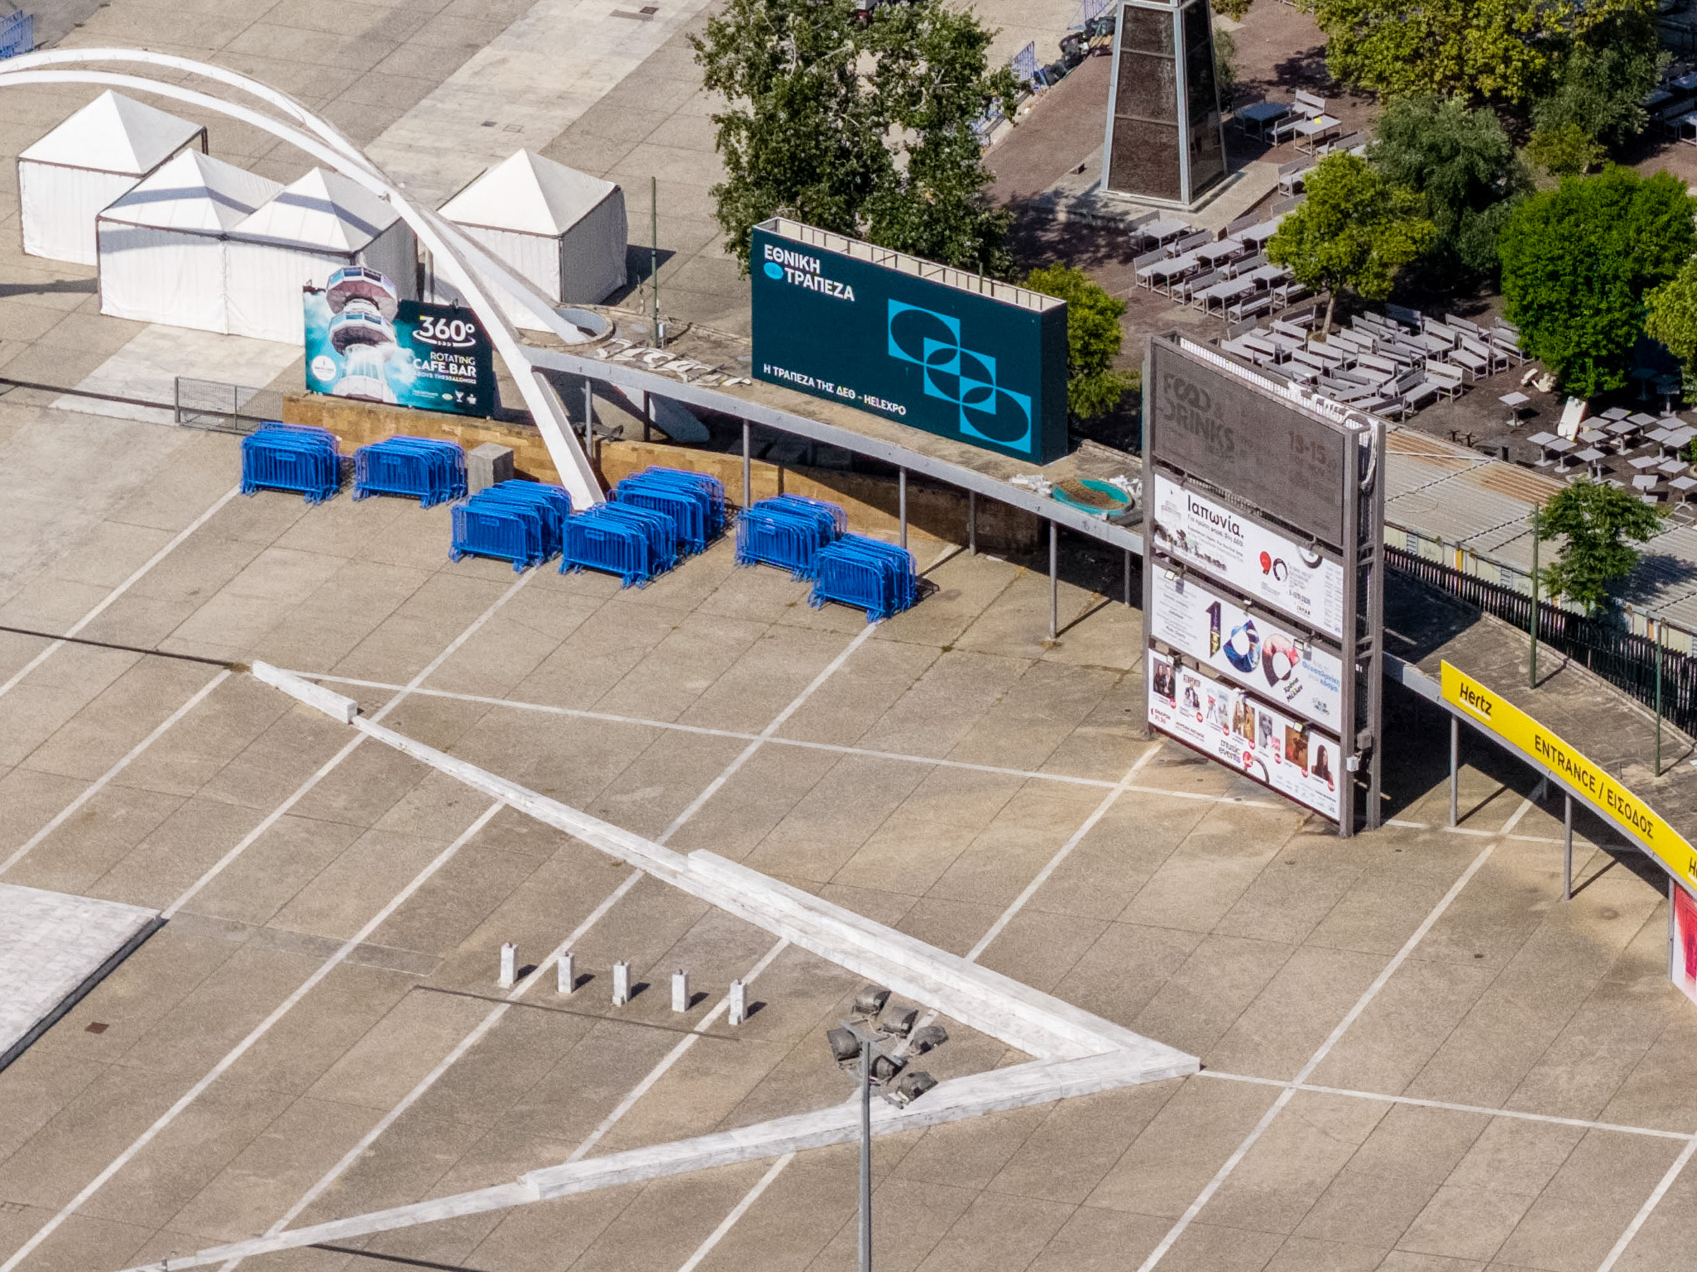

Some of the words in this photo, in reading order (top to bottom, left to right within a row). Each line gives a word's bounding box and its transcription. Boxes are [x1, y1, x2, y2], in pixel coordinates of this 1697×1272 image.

[763, 243, 821, 275] ΕΘΝΙΚΗ
[784, 267, 855, 303] ΤΡΑΠΕΖΑ
[420, 314, 476, 342] 360°
[430, 351, 476, 367] ROTATING
[449, 362, 477, 378] BAR
[763, 362, 771, 375] Η
[772, 366, 815, 388] ΤΡΑΠΕΖΑ
[816, 378, 835, 394] ΤΗΣ
[835, 385, 856, 400] ΔΕΘ
[863, 394, 907, 416] HELEXPO
[1187, 494, 1244, 539] Ιαπωνία.
[1459, 682, 1493, 717] Hertz
[1534, 733, 1596, 793] ENTRANCE
[1607, 788, 1654, 840] ΕΙΣΟΔΟΣ
